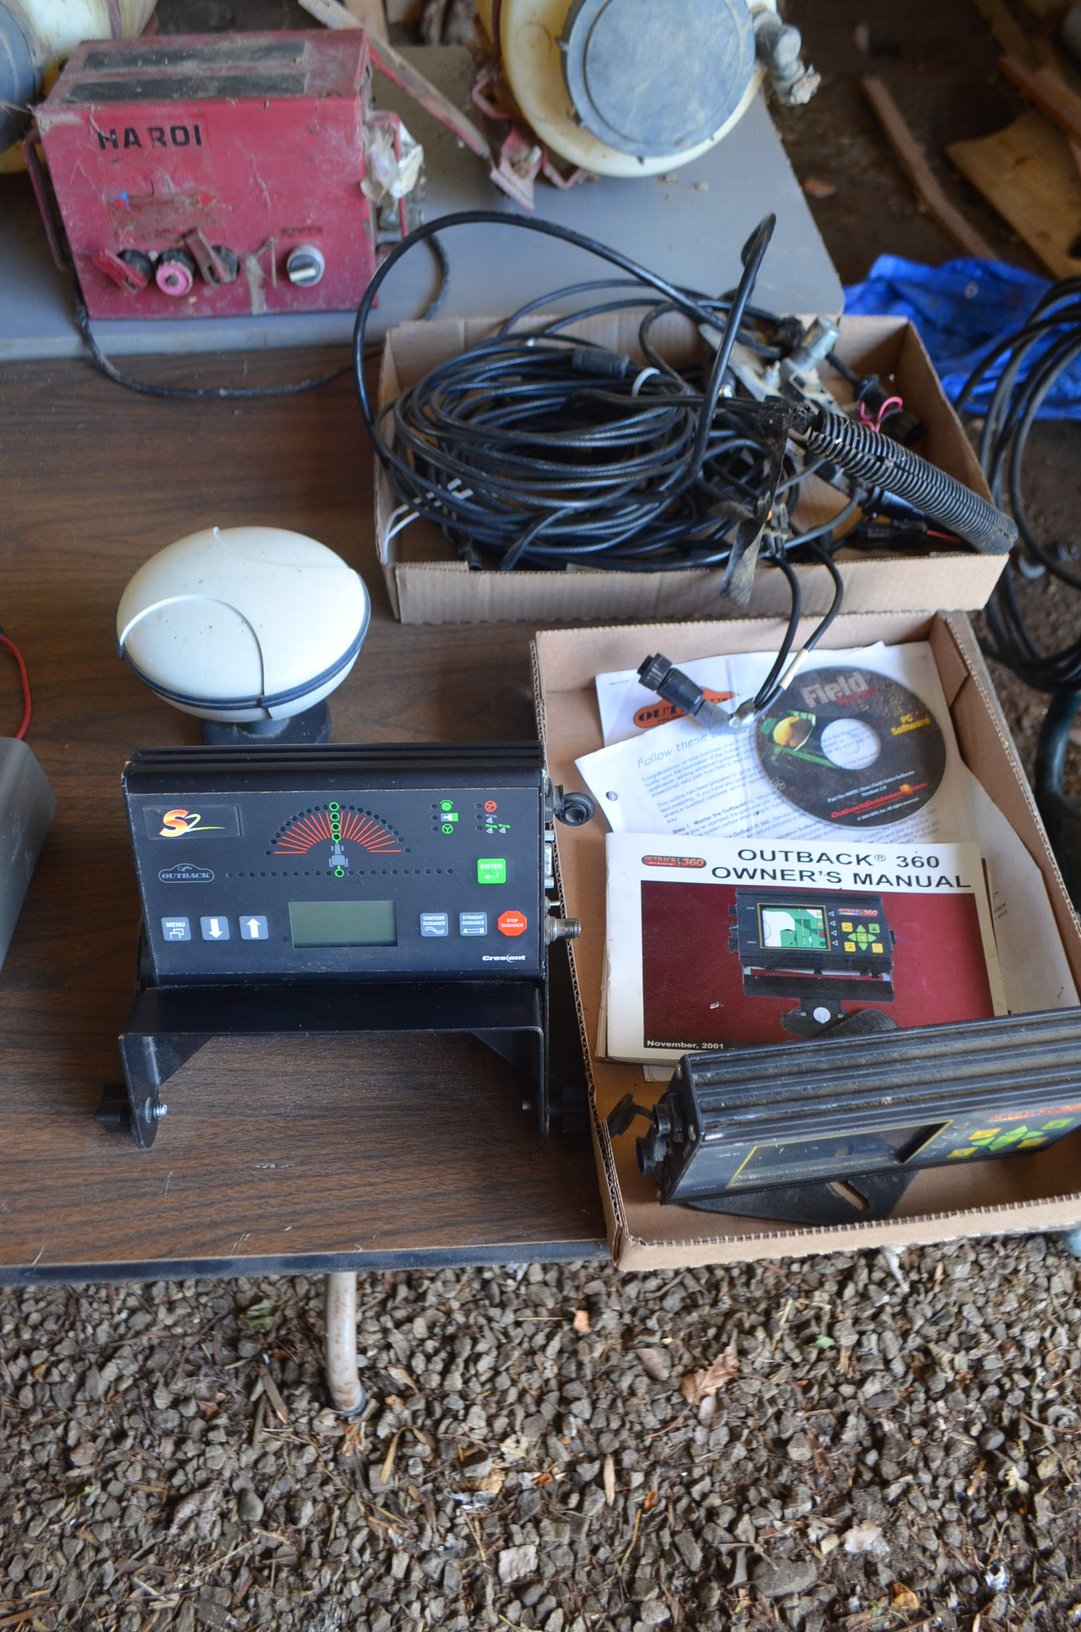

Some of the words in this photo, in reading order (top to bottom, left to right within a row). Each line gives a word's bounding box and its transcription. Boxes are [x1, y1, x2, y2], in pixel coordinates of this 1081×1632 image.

[98, 124, 203, 149] HARDI
[637, 748, 673, 769] Follow
[676, 733, 707, 752] these
[682, 858, 705, 867] 360
[896, 855, 940, 868] 360
[711, 866, 842, 884] OWNER'S
[853, 873, 971, 888] MANUAL
[482, 953, 526, 963] Crescent
[646, 1040, 699, 1049] November,
